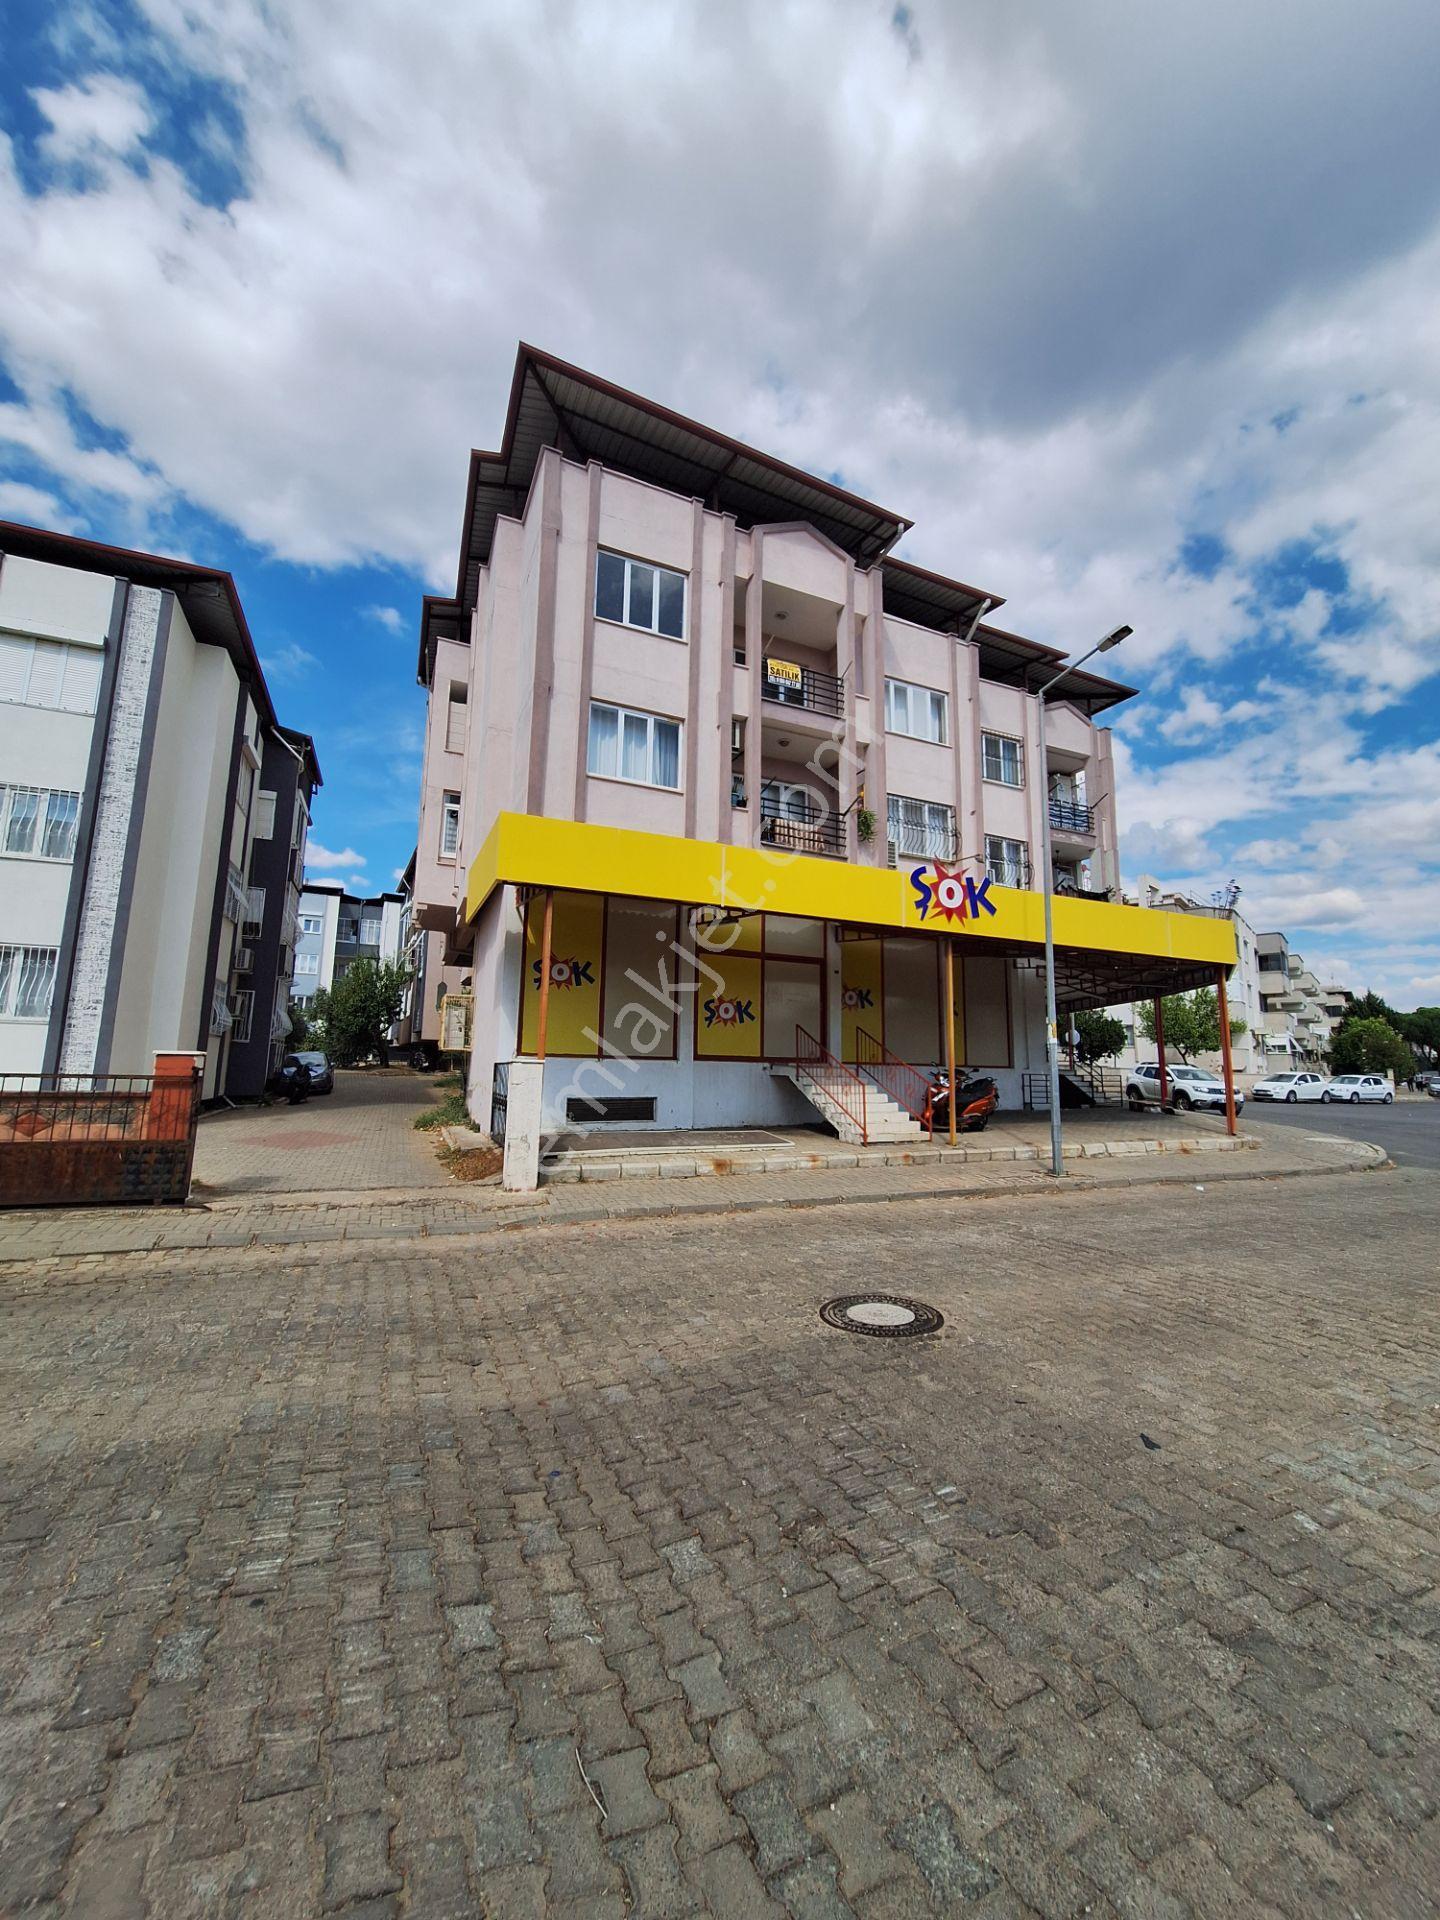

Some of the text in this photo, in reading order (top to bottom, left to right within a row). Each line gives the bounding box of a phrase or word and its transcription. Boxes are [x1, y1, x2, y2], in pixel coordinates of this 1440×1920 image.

[770, 666, 799, 682] SATILIK
[910, 866, 998, 922] ŞOK
[843, 988, 874, 1010] OK
[703, 998, 756, 1028] ŞOK
